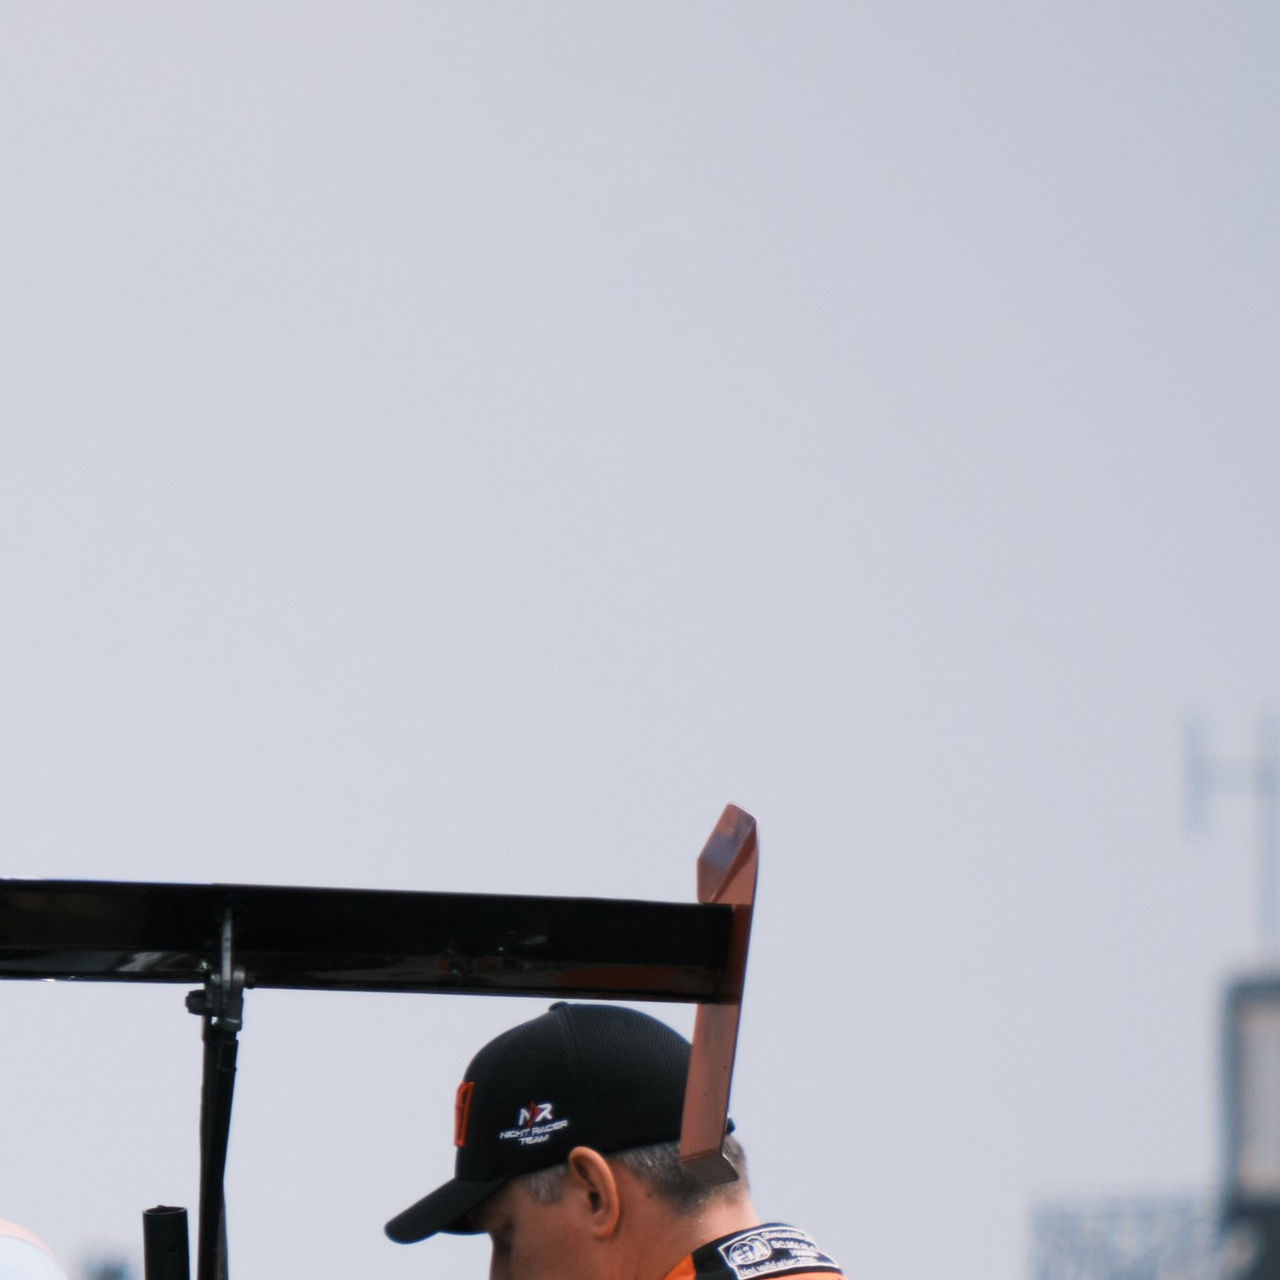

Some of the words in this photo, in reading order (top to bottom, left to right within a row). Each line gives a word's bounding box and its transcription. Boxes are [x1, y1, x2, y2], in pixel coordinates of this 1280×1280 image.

[499, 1128, 531, 1139] NIGHT
[531, 1119, 568, 1136] RACER
[519, 1134, 550, 1145] TEAM
